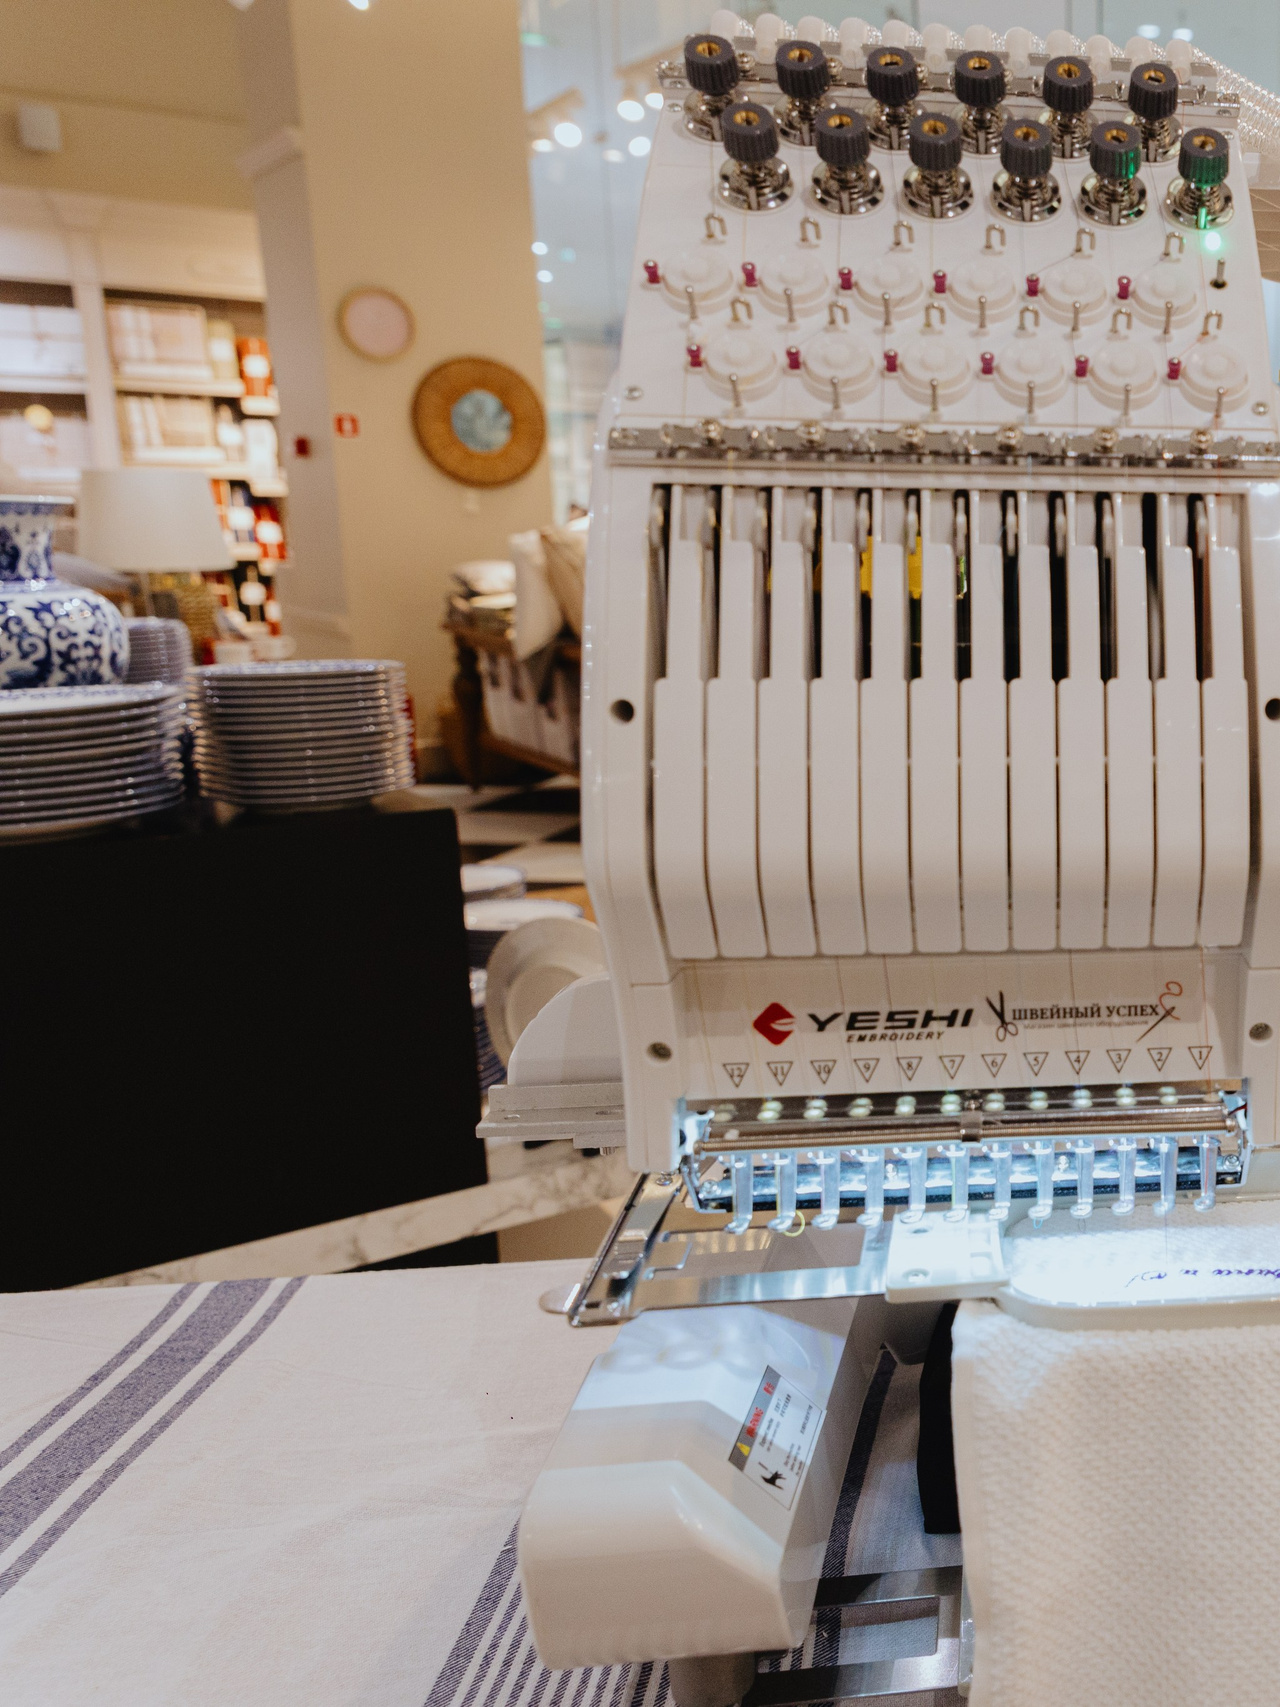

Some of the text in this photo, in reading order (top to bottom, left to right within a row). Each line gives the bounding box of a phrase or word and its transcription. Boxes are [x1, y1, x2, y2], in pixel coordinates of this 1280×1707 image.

[808, 1008, 974, 1032] YESHI
[1012, 1003, 1161, 1021] ШВЕЙНЫЙ УСПЕХ
[846, 1031, 945, 1043] EMBROIDERY
